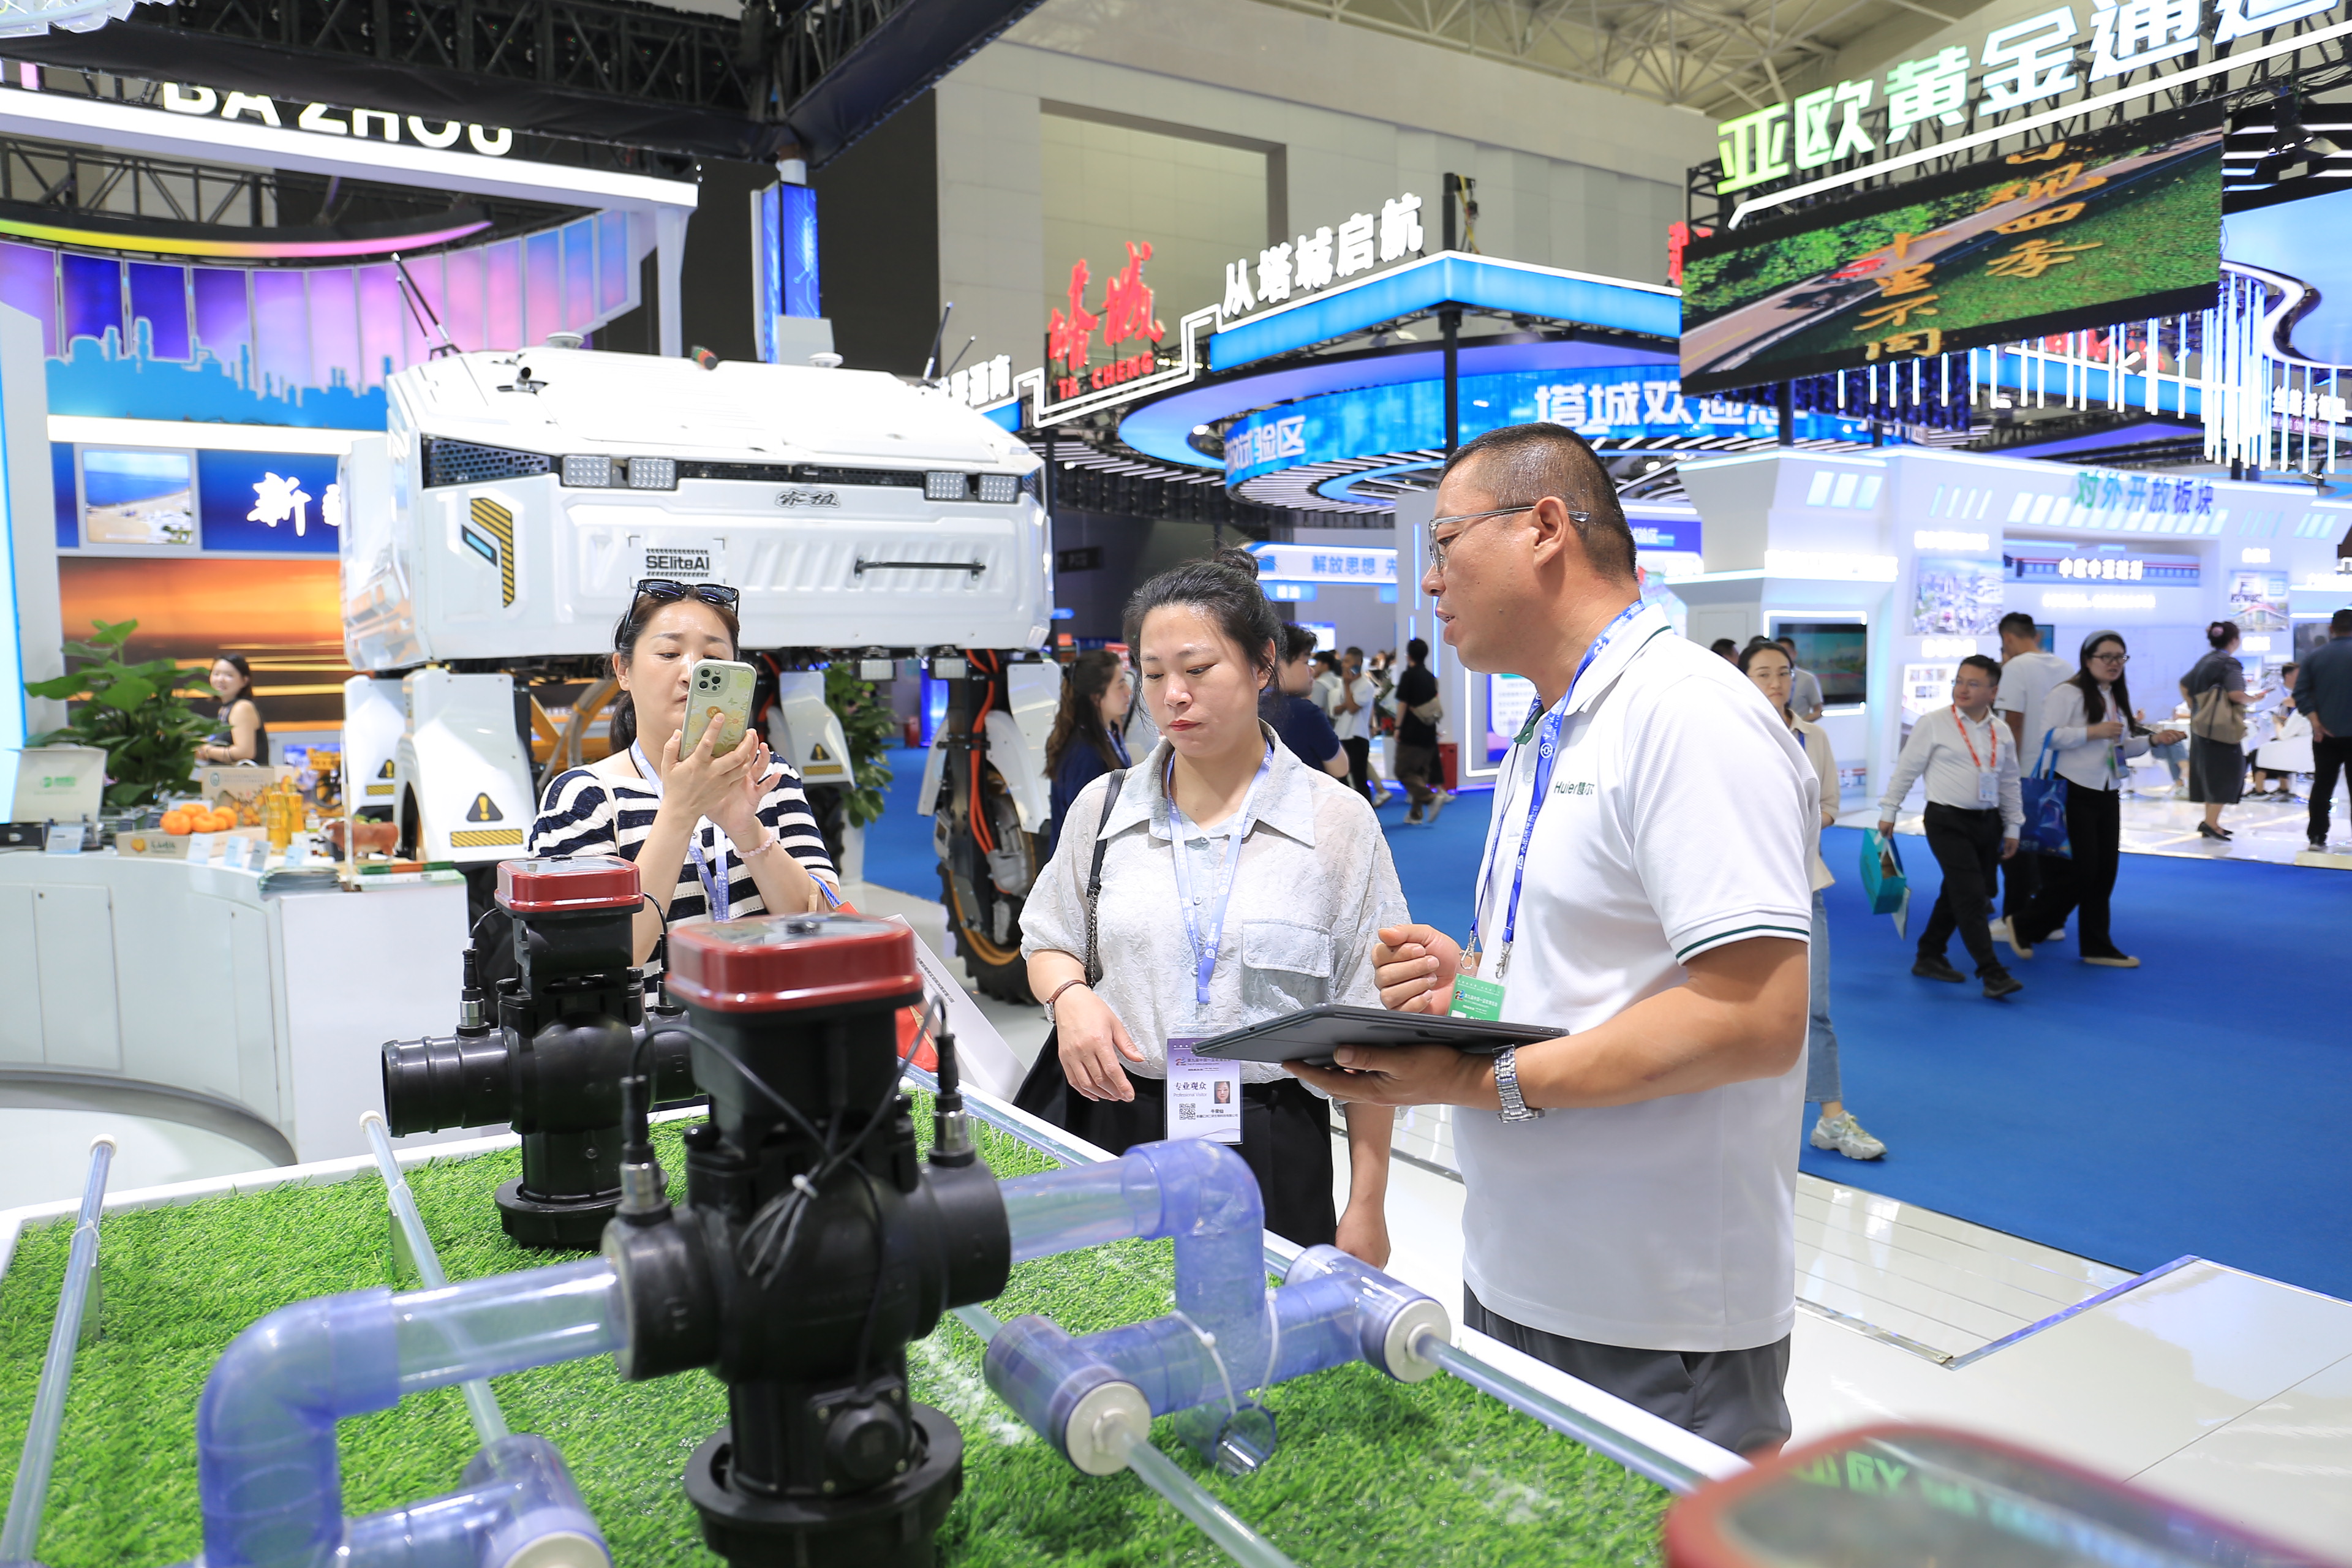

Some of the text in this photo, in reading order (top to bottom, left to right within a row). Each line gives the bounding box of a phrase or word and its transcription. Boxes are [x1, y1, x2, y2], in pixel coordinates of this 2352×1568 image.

[1222, 192, 1423, 318] 从塔城启航
[1058, 350, 1153, 399] TA CHENG
[2075, 471, 2214, 514] 对外开放板块
[646, 555, 709, 570] SEliteAI
[1313, 555, 1376, 575] 解放思想
[1174, 1082, 1207, 1091] 专业观众
